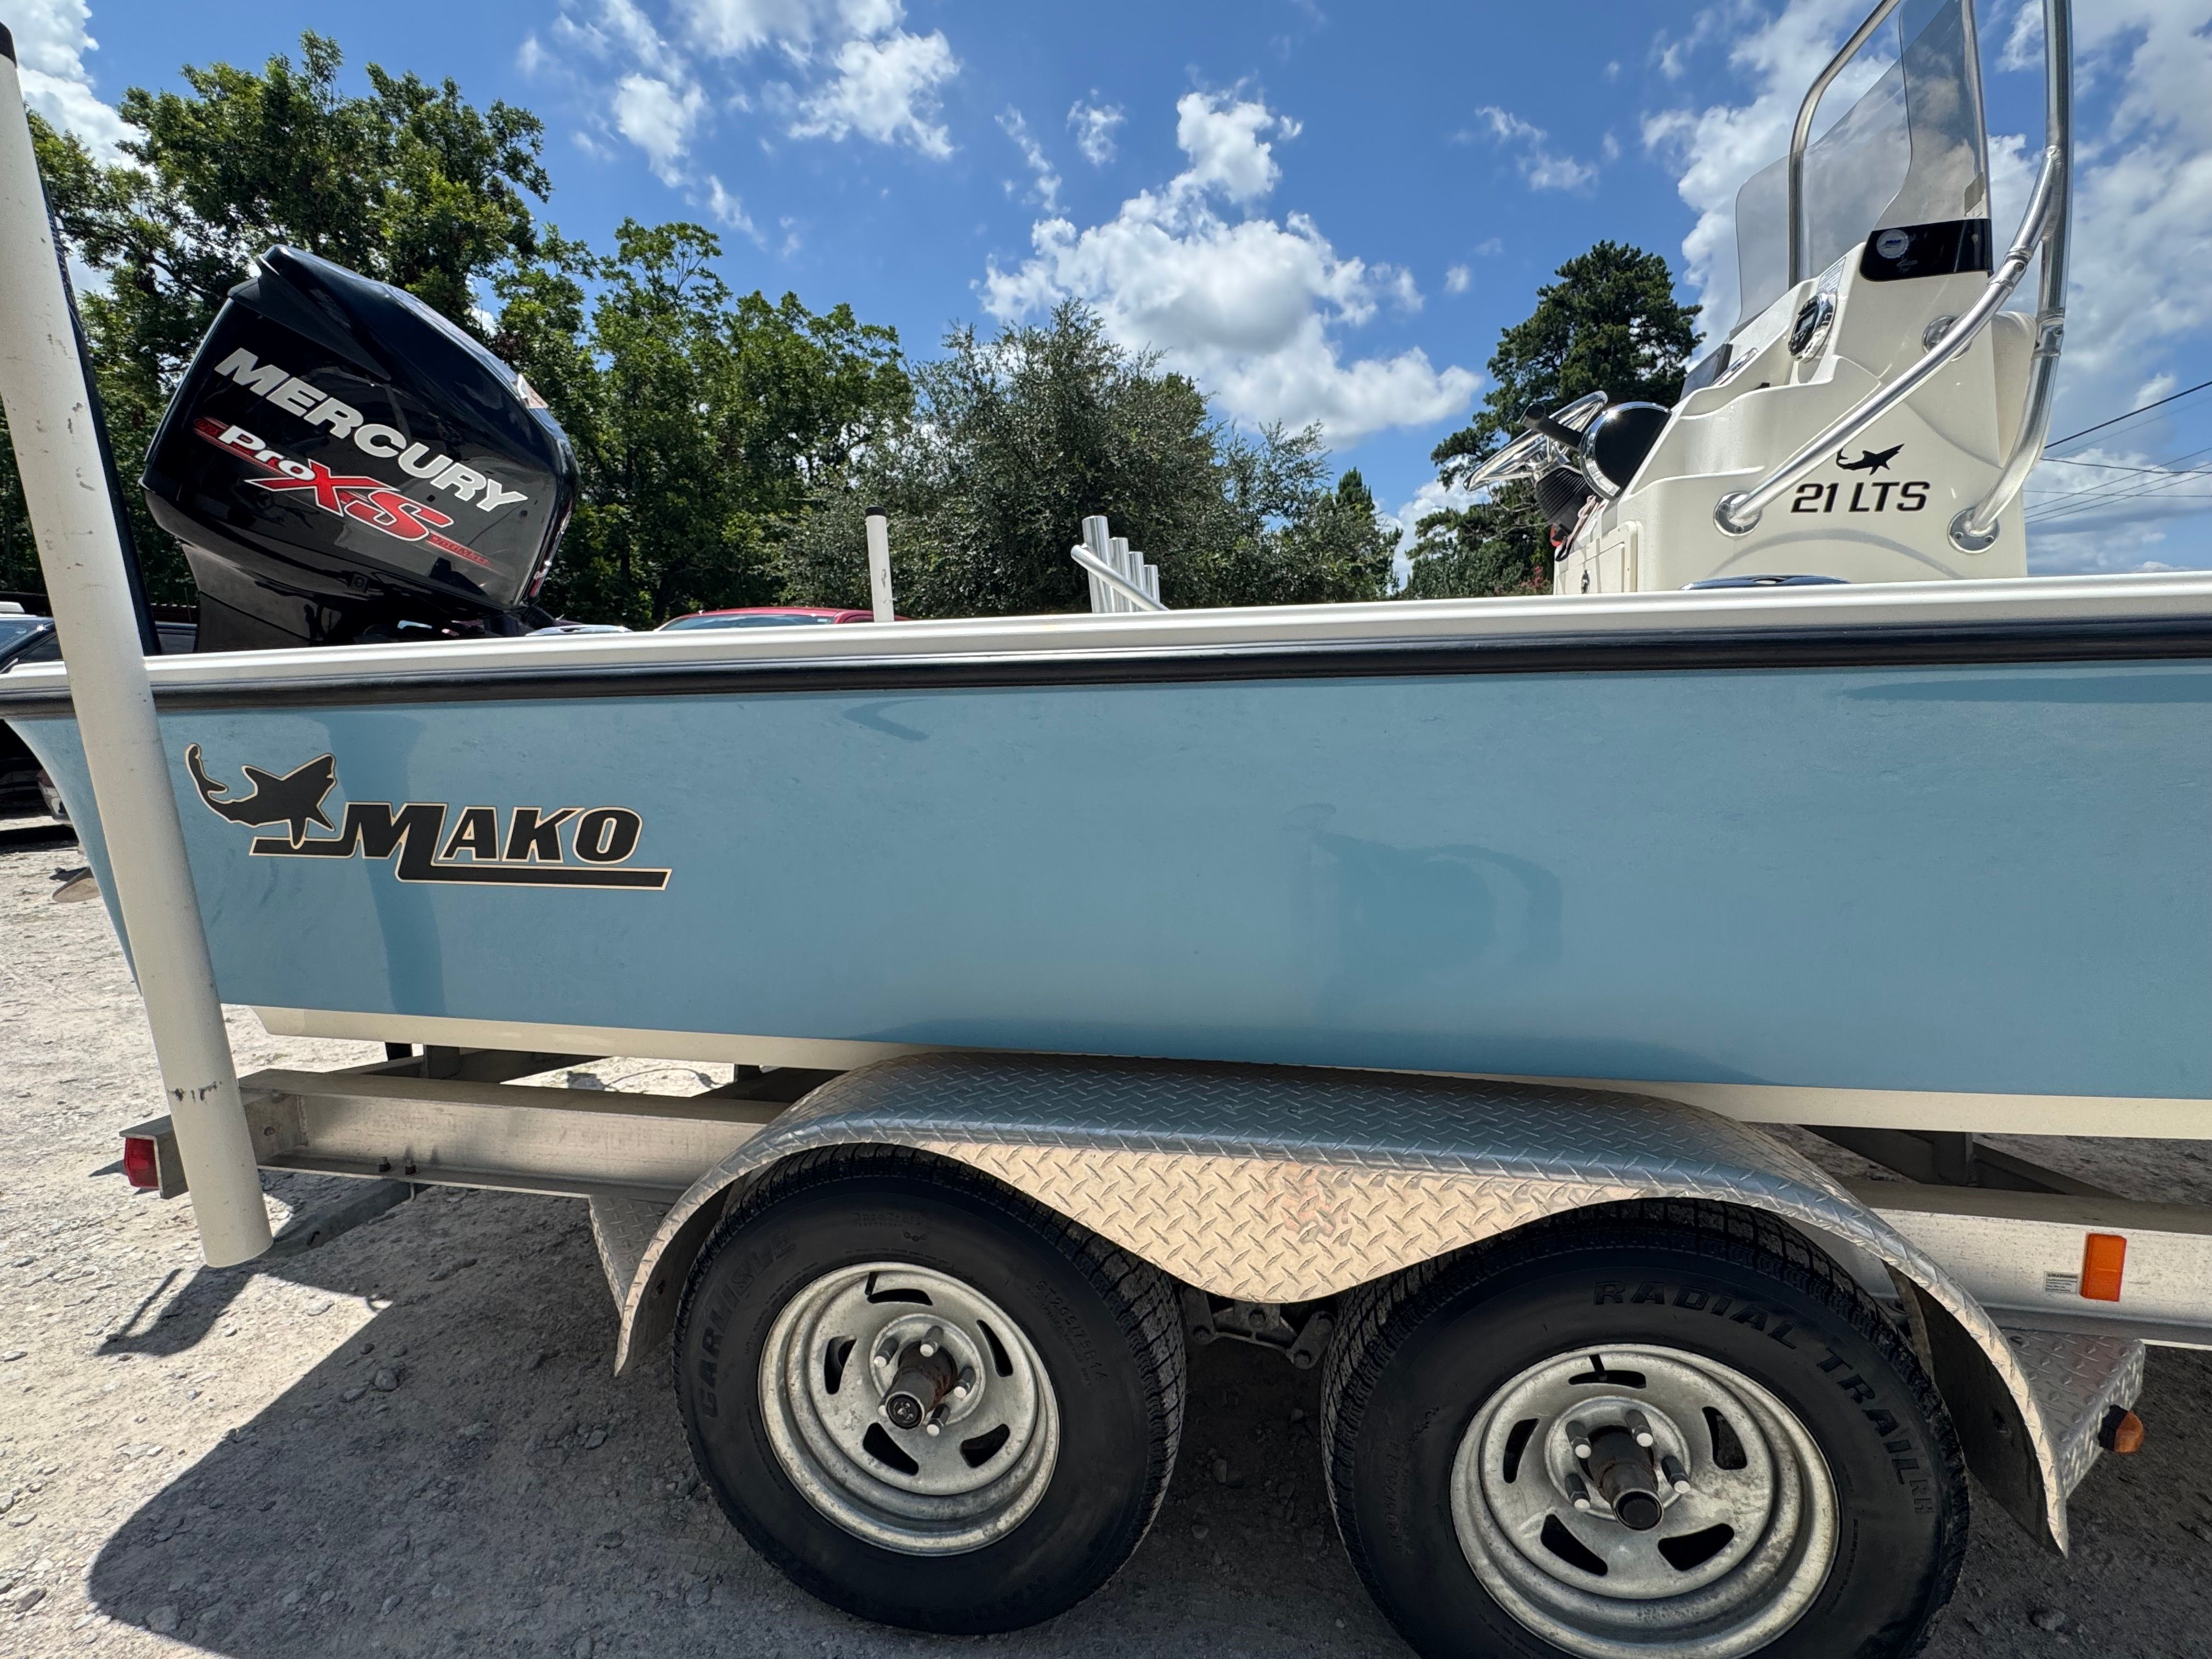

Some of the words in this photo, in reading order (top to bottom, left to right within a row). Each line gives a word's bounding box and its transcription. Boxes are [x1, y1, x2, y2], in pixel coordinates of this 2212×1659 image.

[215, 347, 528, 513] MERCURY
[1791, 482, 1838, 514] 21
[1848, 480, 1931, 513] LTS
[345, 801, 643, 883] MAKO
[696, 1227, 797, 1418] CARLISLE
[1593, 1280, 1799, 1350] RADIAL
[1816, 1347, 1920, 1485] TRAIL
